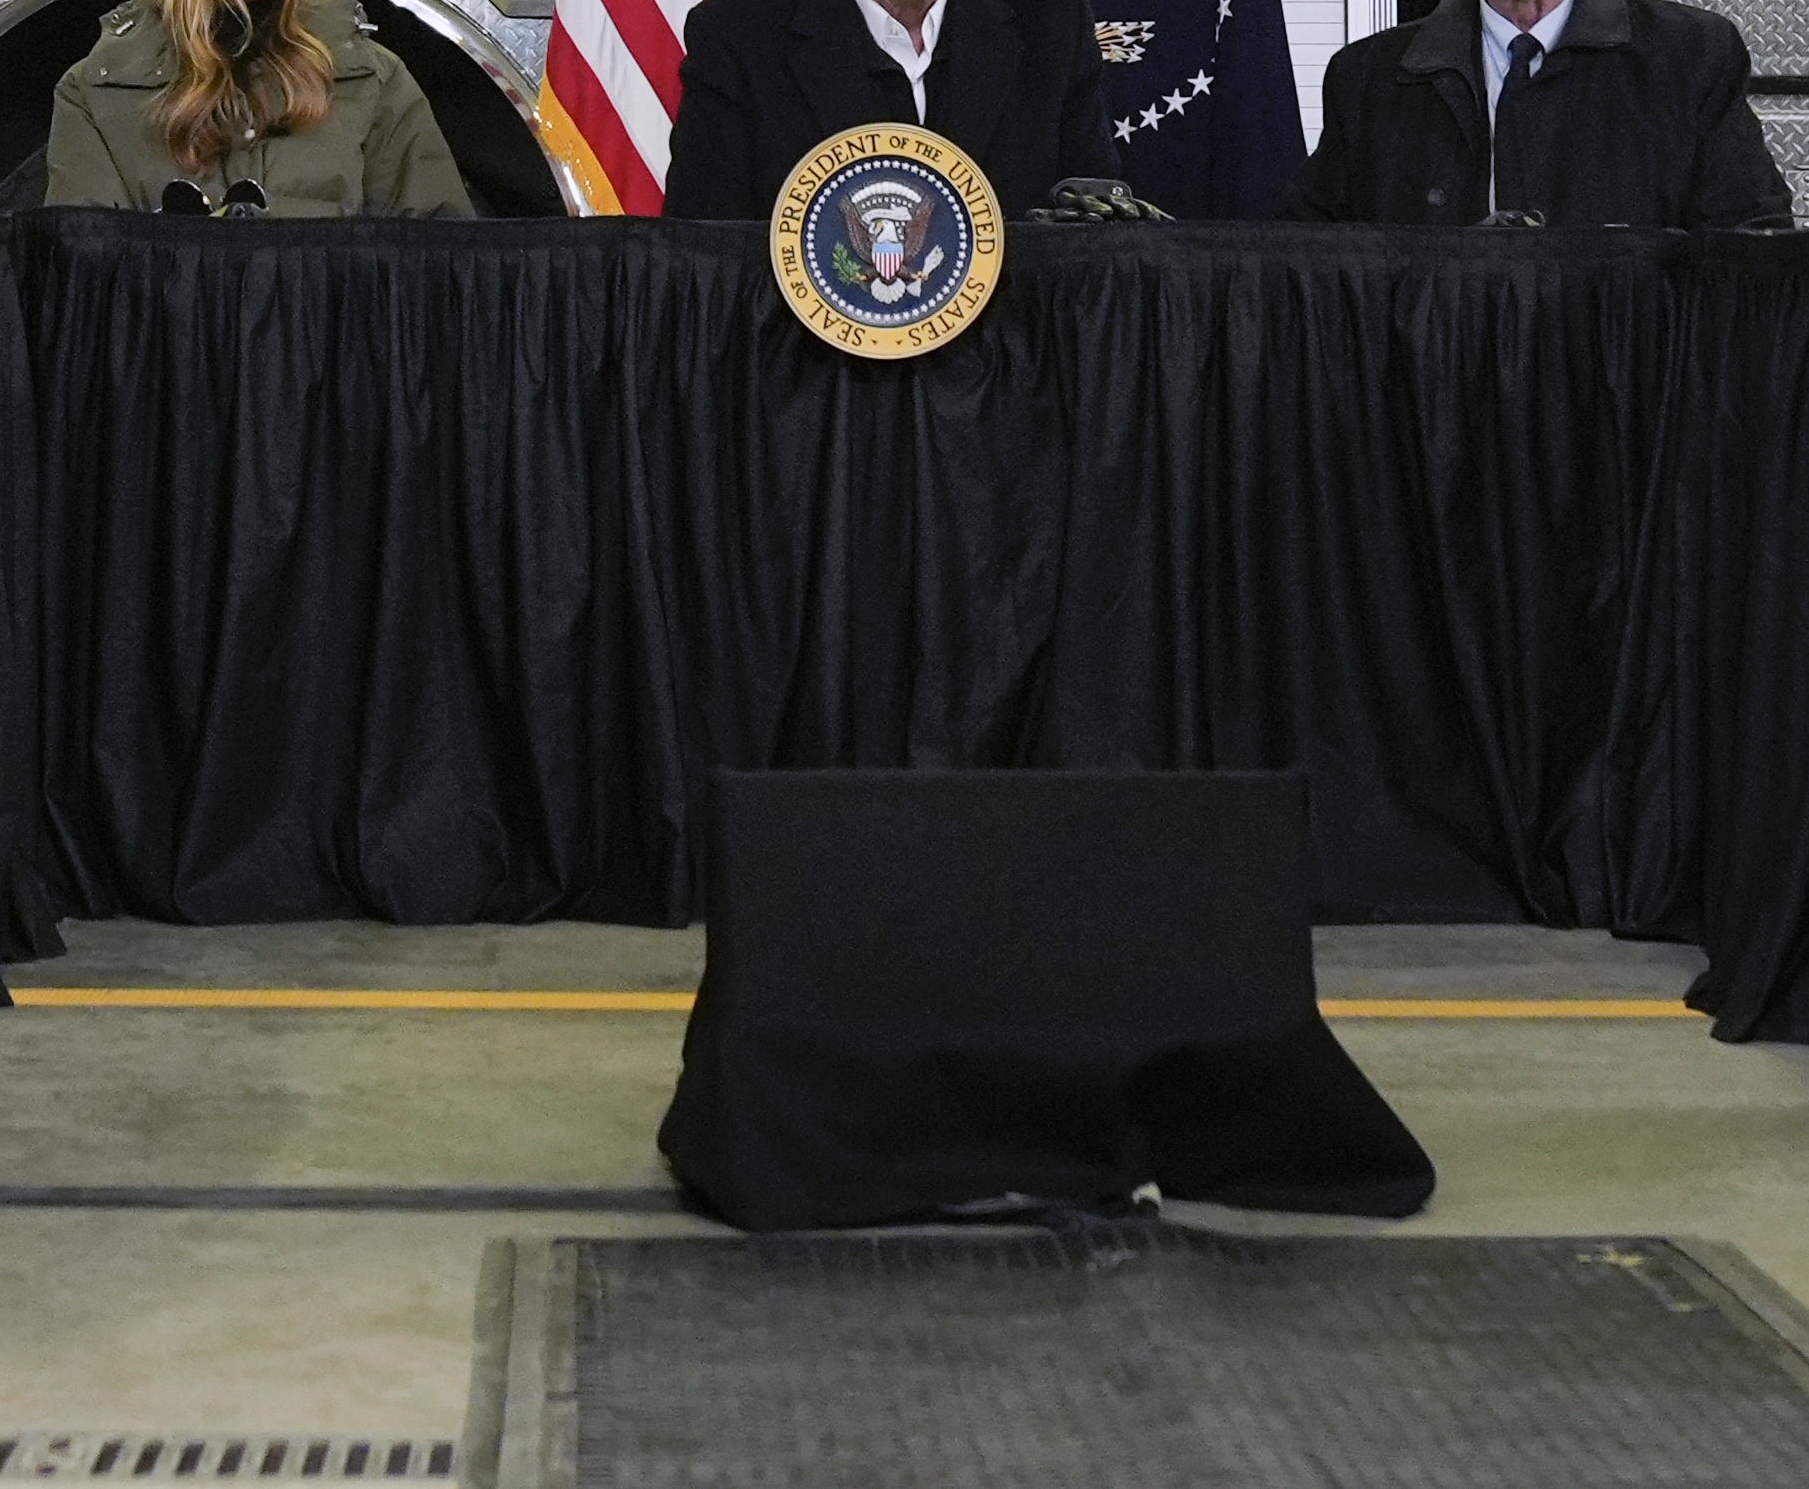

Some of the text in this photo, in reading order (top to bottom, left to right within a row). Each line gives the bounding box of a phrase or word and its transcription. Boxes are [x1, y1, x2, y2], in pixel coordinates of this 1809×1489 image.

[778, 133, 995, 347] SEAL OF THE PRESIDENT OF THE UNITED STATES
